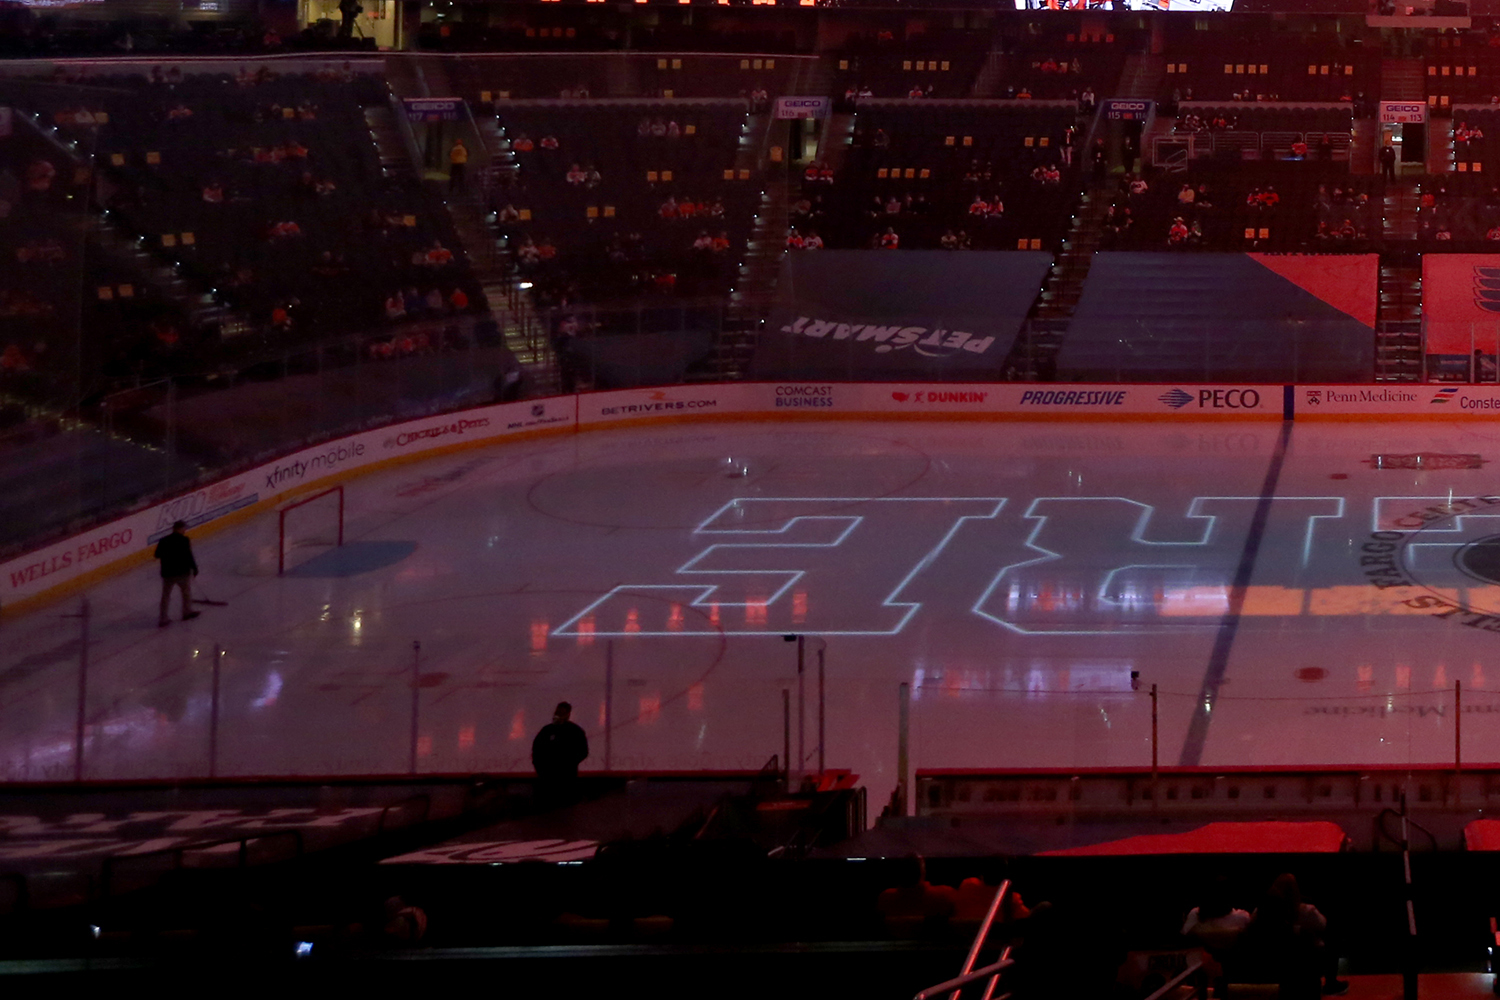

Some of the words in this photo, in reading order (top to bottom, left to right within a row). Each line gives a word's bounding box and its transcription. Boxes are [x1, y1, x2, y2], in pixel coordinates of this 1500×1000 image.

[785, 100, 821, 108] GEICO
[1111, 102, 1145, 110] GEICO
[1386, 105, 1420, 113] GEICO
[1108, 111, 1121, 120] 115
[1410, 114, 1422, 122] 113
[781, 316, 996, 355] PETSMART
[775, 386, 832, 397] COMCAST
[927, 391, 985, 404] DUNKIN'
[1019, 391, 1126, 405] PROGRESSIVE
[1326, 390, 1357, 403] Penn
[1359, 389, 1418, 403] Medicine
[775, 397, 833, 407] BUSINESS
[1199, 389, 1260, 408] PECO
[602, 399, 718, 416] BETRIVERS.COM
[266, 460, 308, 489] xfinity
[311, 441, 366, 475] mobile
[10, 551, 73, 590] WELLS
[76, 529, 133, 563] FARGO
[1360, 530, 1412, 590] FARGO
